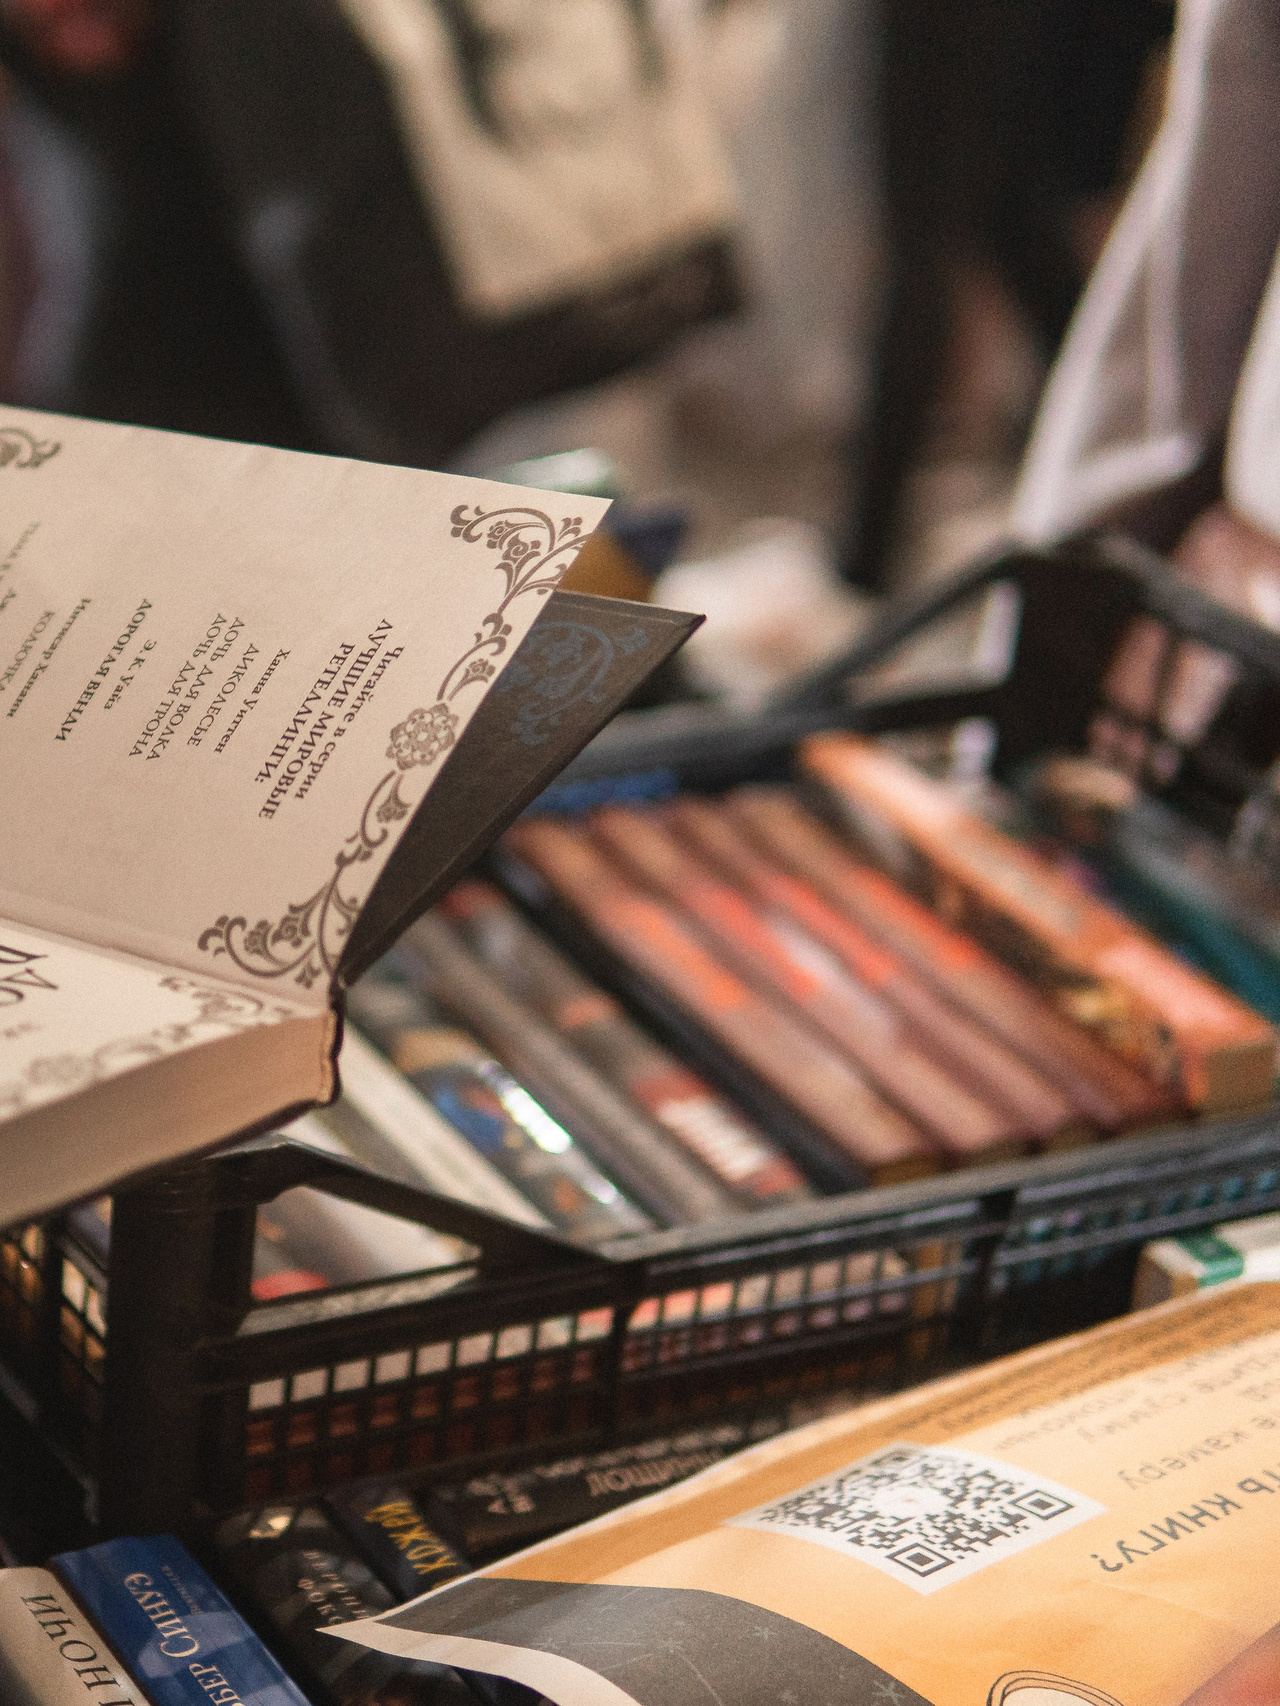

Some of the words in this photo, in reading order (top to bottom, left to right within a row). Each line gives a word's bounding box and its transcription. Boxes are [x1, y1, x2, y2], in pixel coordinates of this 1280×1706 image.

[42, 597, 92, 660] Интисар
[96, 598, 152, 677] ДОРОГАЯ
[192, 613, 227, 658] ДОЧЬ
[210, 616, 245, 662] ДОЧЬ
[6, 664, 48, 718] Ханани
[104, 675, 135, 710] Уайз
[167, 660, 196, 696] ДЛЯ
[185, 664, 213, 700] ДЛЯ
[252, 649, 291, 695] Ханна
[327, 618, 393, 708] ЛУЧШИЕ
[343, 646, 405, 723] Читайте
[55, 680, 101, 741] ВЕНДИ
[187, 643, 260, 747] ДИКОЛЕСЬЕ
[254, 642, 356, 783] РЕТЕЛЛИНГИ:
[128, 700, 175, 757] ТРОНА
[146, 703, 191, 761] ВОЛКА
[214, 698, 259, 754] Уиттен
[333, 727, 347, 737] в
[258, 711, 334, 819] МИРОВЫЕ
[294, 741, 336, 800] серии
[1117, 1427, 1251, 1490] камеру
[1090, 1493, 1243, 1573] КНИГУ?
[21, 1593, 121, 1692] НОЧИ
